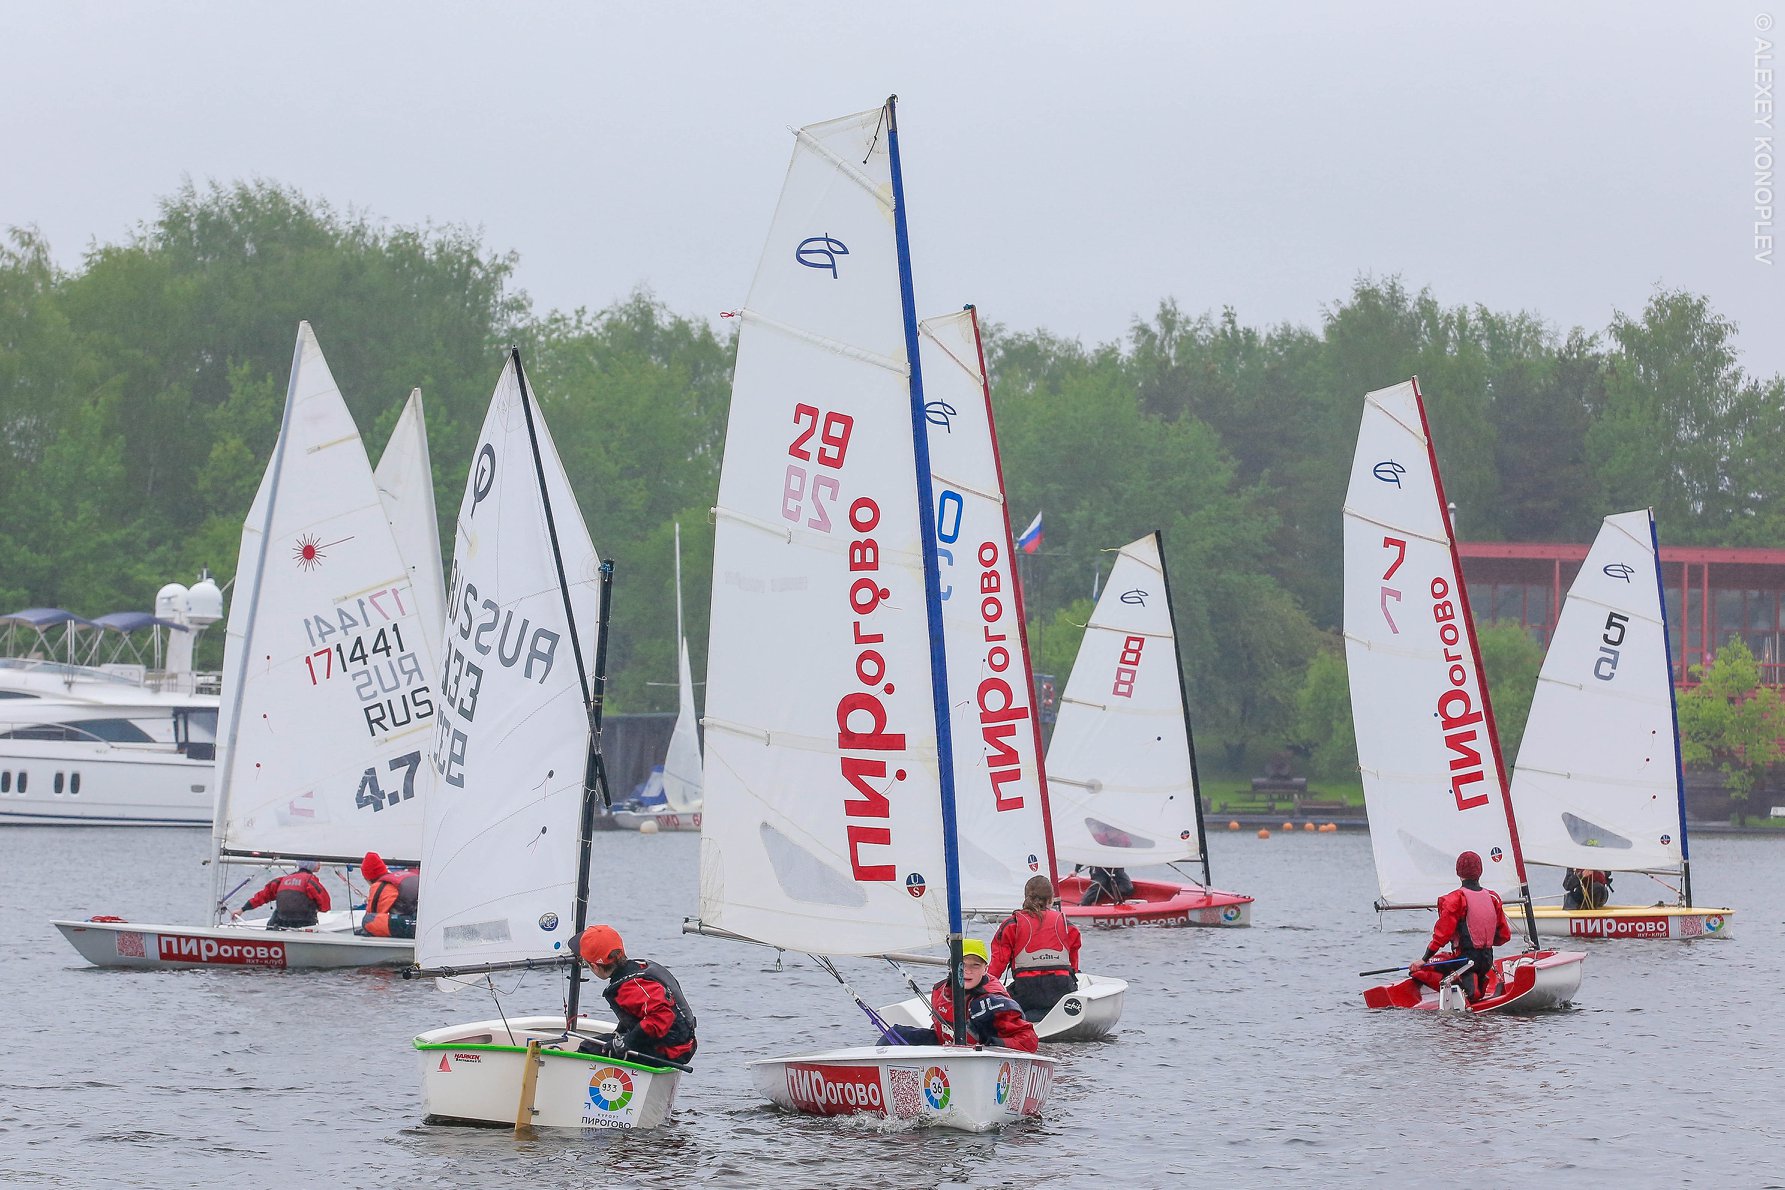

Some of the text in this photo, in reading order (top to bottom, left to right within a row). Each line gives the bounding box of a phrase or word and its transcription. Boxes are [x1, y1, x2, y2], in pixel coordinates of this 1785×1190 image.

[788, 402, 854, 470] 29
[1382, 536, 1407, 581] 7
[1602, 611, 1630, 647] 5
[305, 622, 405, 685] 171441
[1119, 635, 1145, 666] 8
[363, 686, 434, 737] RUS
[355, 750, 422, 813] 4.7
[601, 1083, 617, 1092] 933
[932, 1082, 943, 1094] 36
[581, 1116, 632, 1129] ПИРОГОВО
